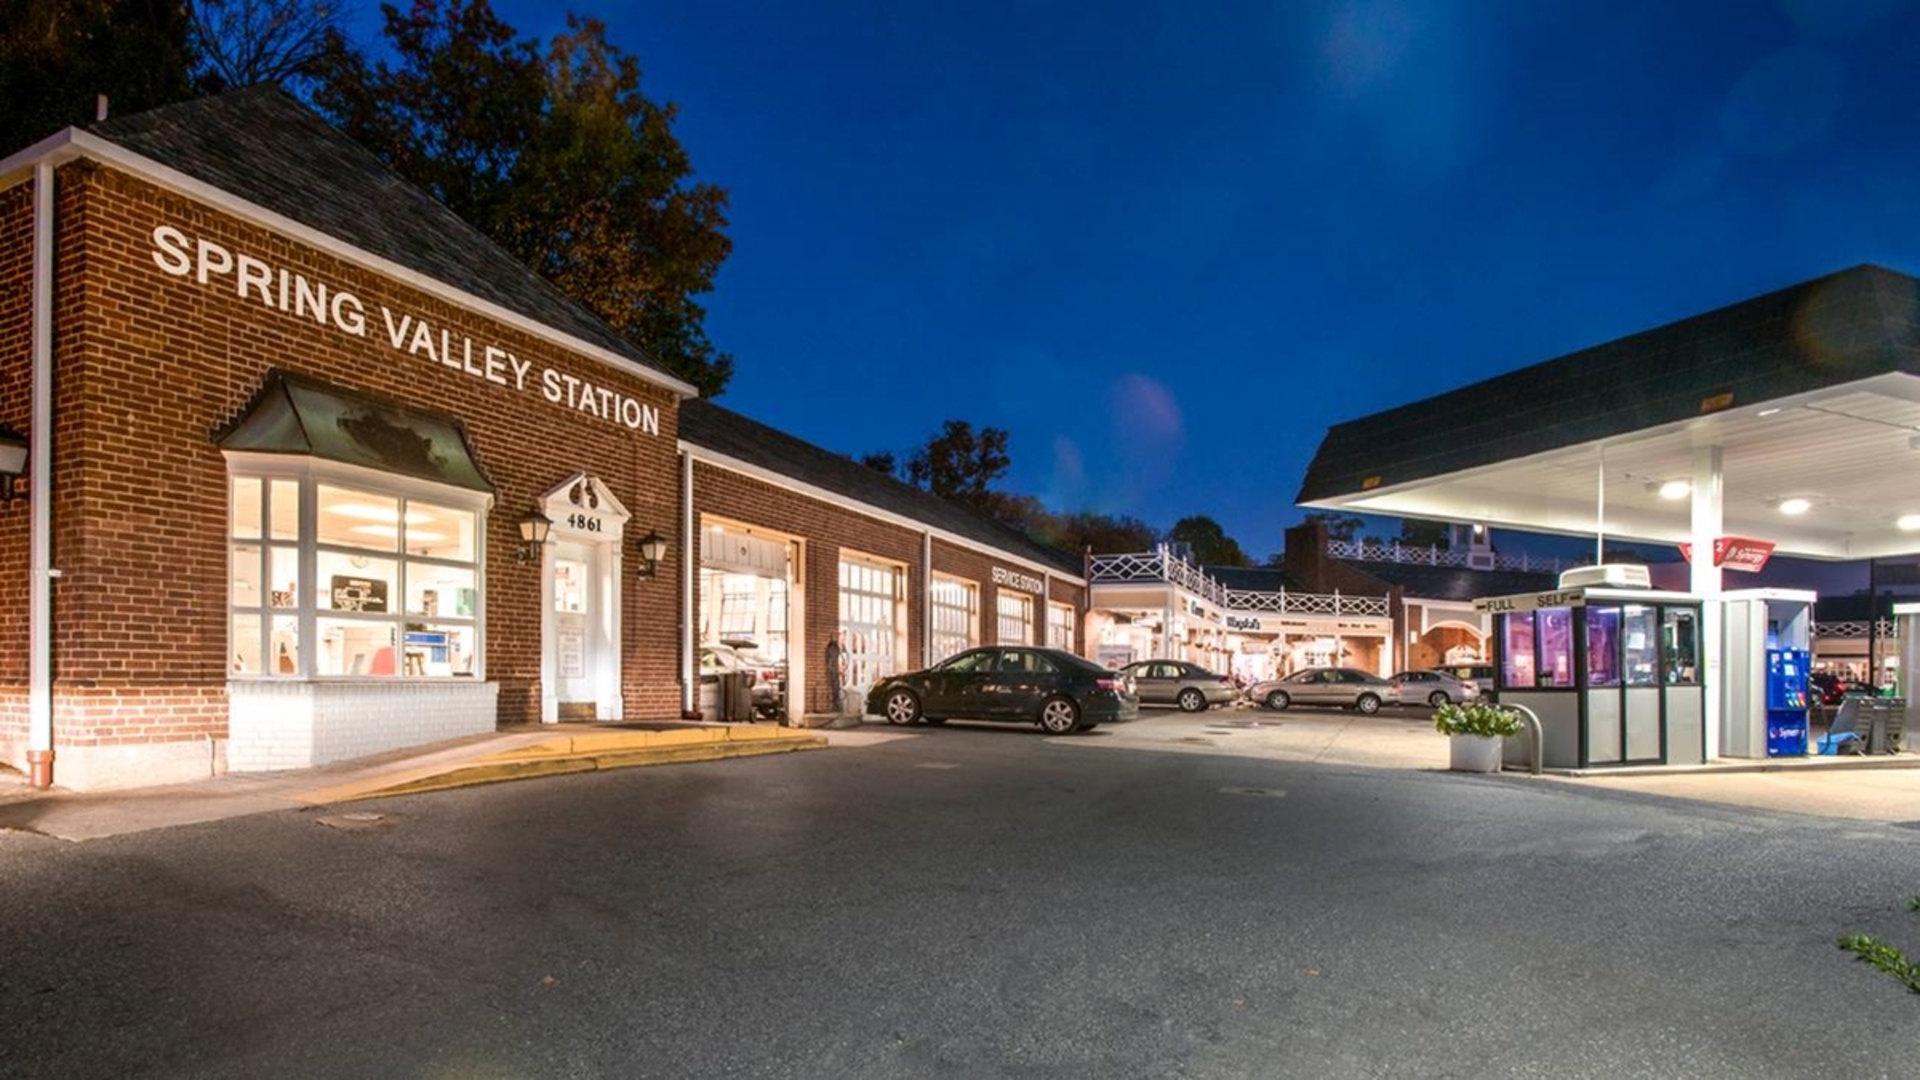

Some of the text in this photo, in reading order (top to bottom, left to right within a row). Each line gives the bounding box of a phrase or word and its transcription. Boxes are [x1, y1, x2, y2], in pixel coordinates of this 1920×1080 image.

[151, 226, 660, 436] SPRING VALLEY STATION
[567, 513, 602, 532] 4861
[1715, 541, 1725, 552] 2
[992, 566, 1043, 595] SERVICE STATION
[1487, 593, 1568, 611] FULL SELF
